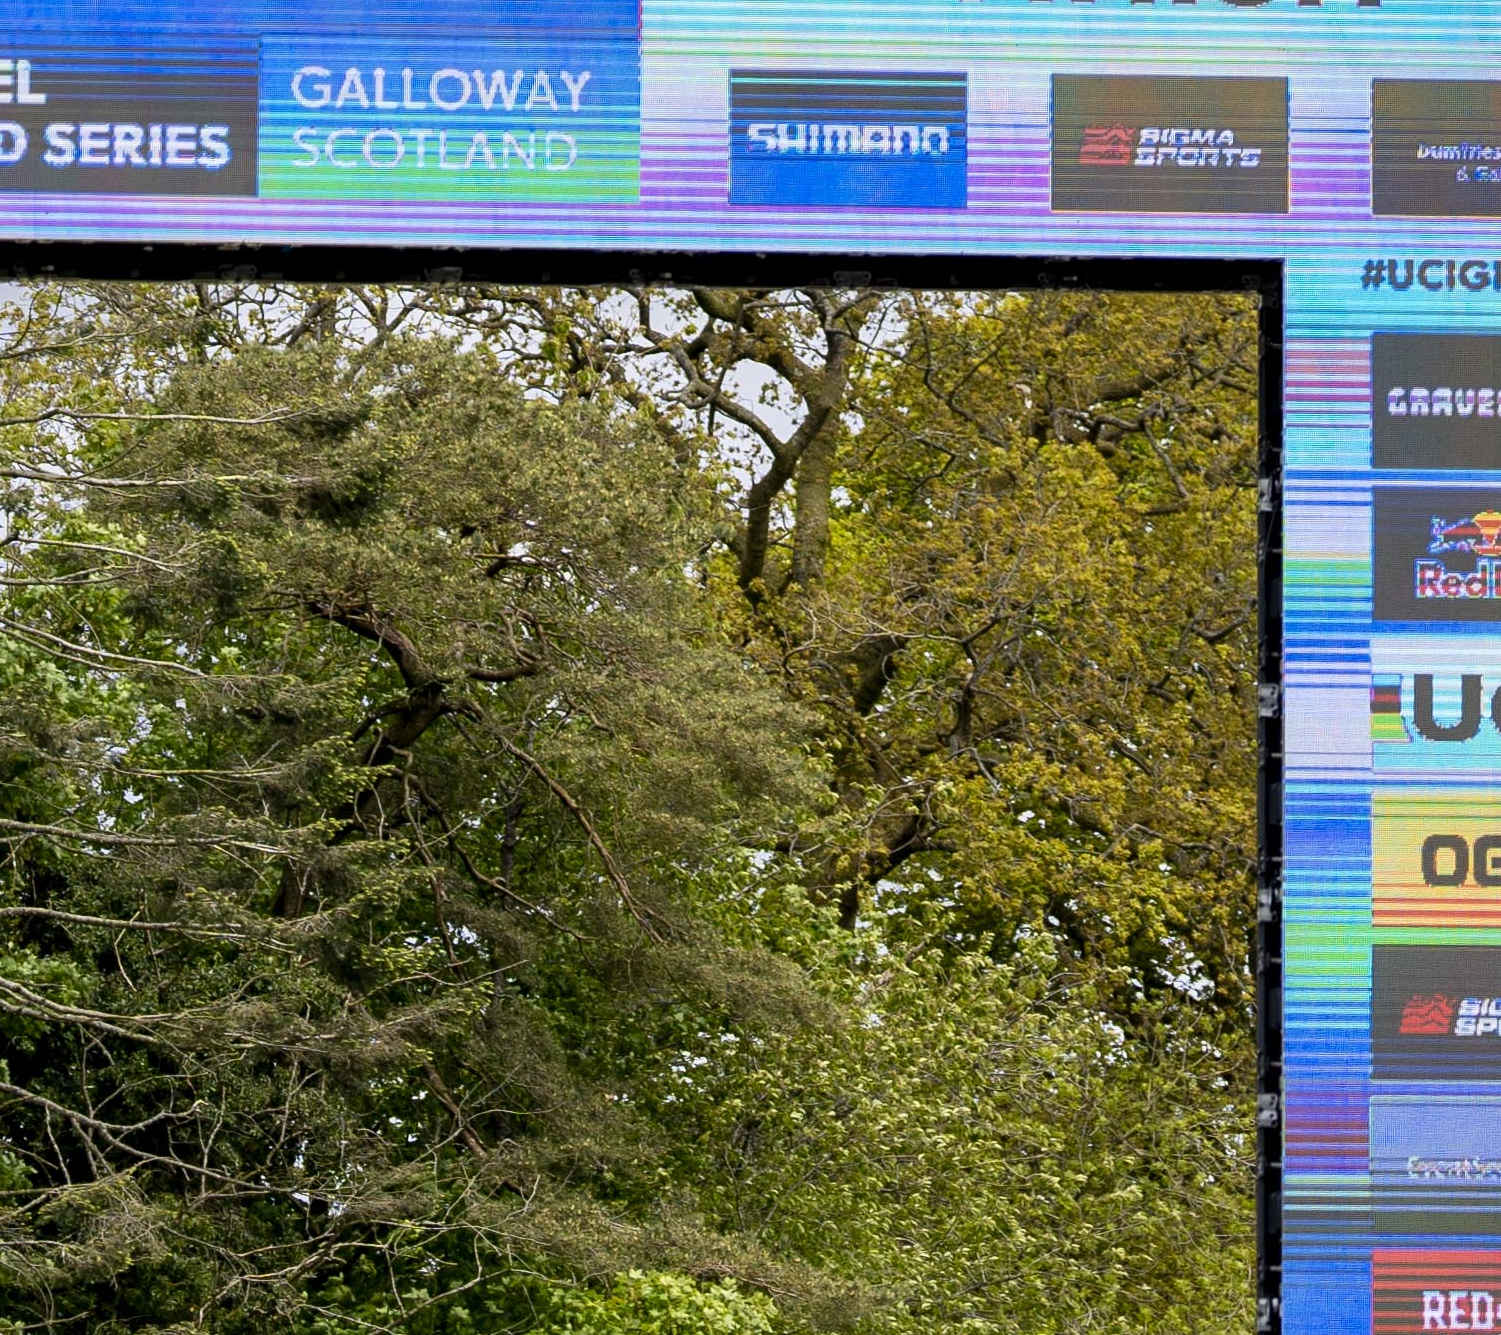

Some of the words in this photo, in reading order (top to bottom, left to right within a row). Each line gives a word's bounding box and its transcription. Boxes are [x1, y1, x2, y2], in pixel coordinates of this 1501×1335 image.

[290, 64, 592, 115] GALLOWAY
[42, 121, 232, 171] SERIES
[290, 122, 580, 175] SCOTLAND
[747, 123, 948, 155] SHIMANO
[1137, 127, 1235, 147] SIGMA
[1134, 147, 1263, 167] SPORTS
[1415, 561, 1488, 598] Red
